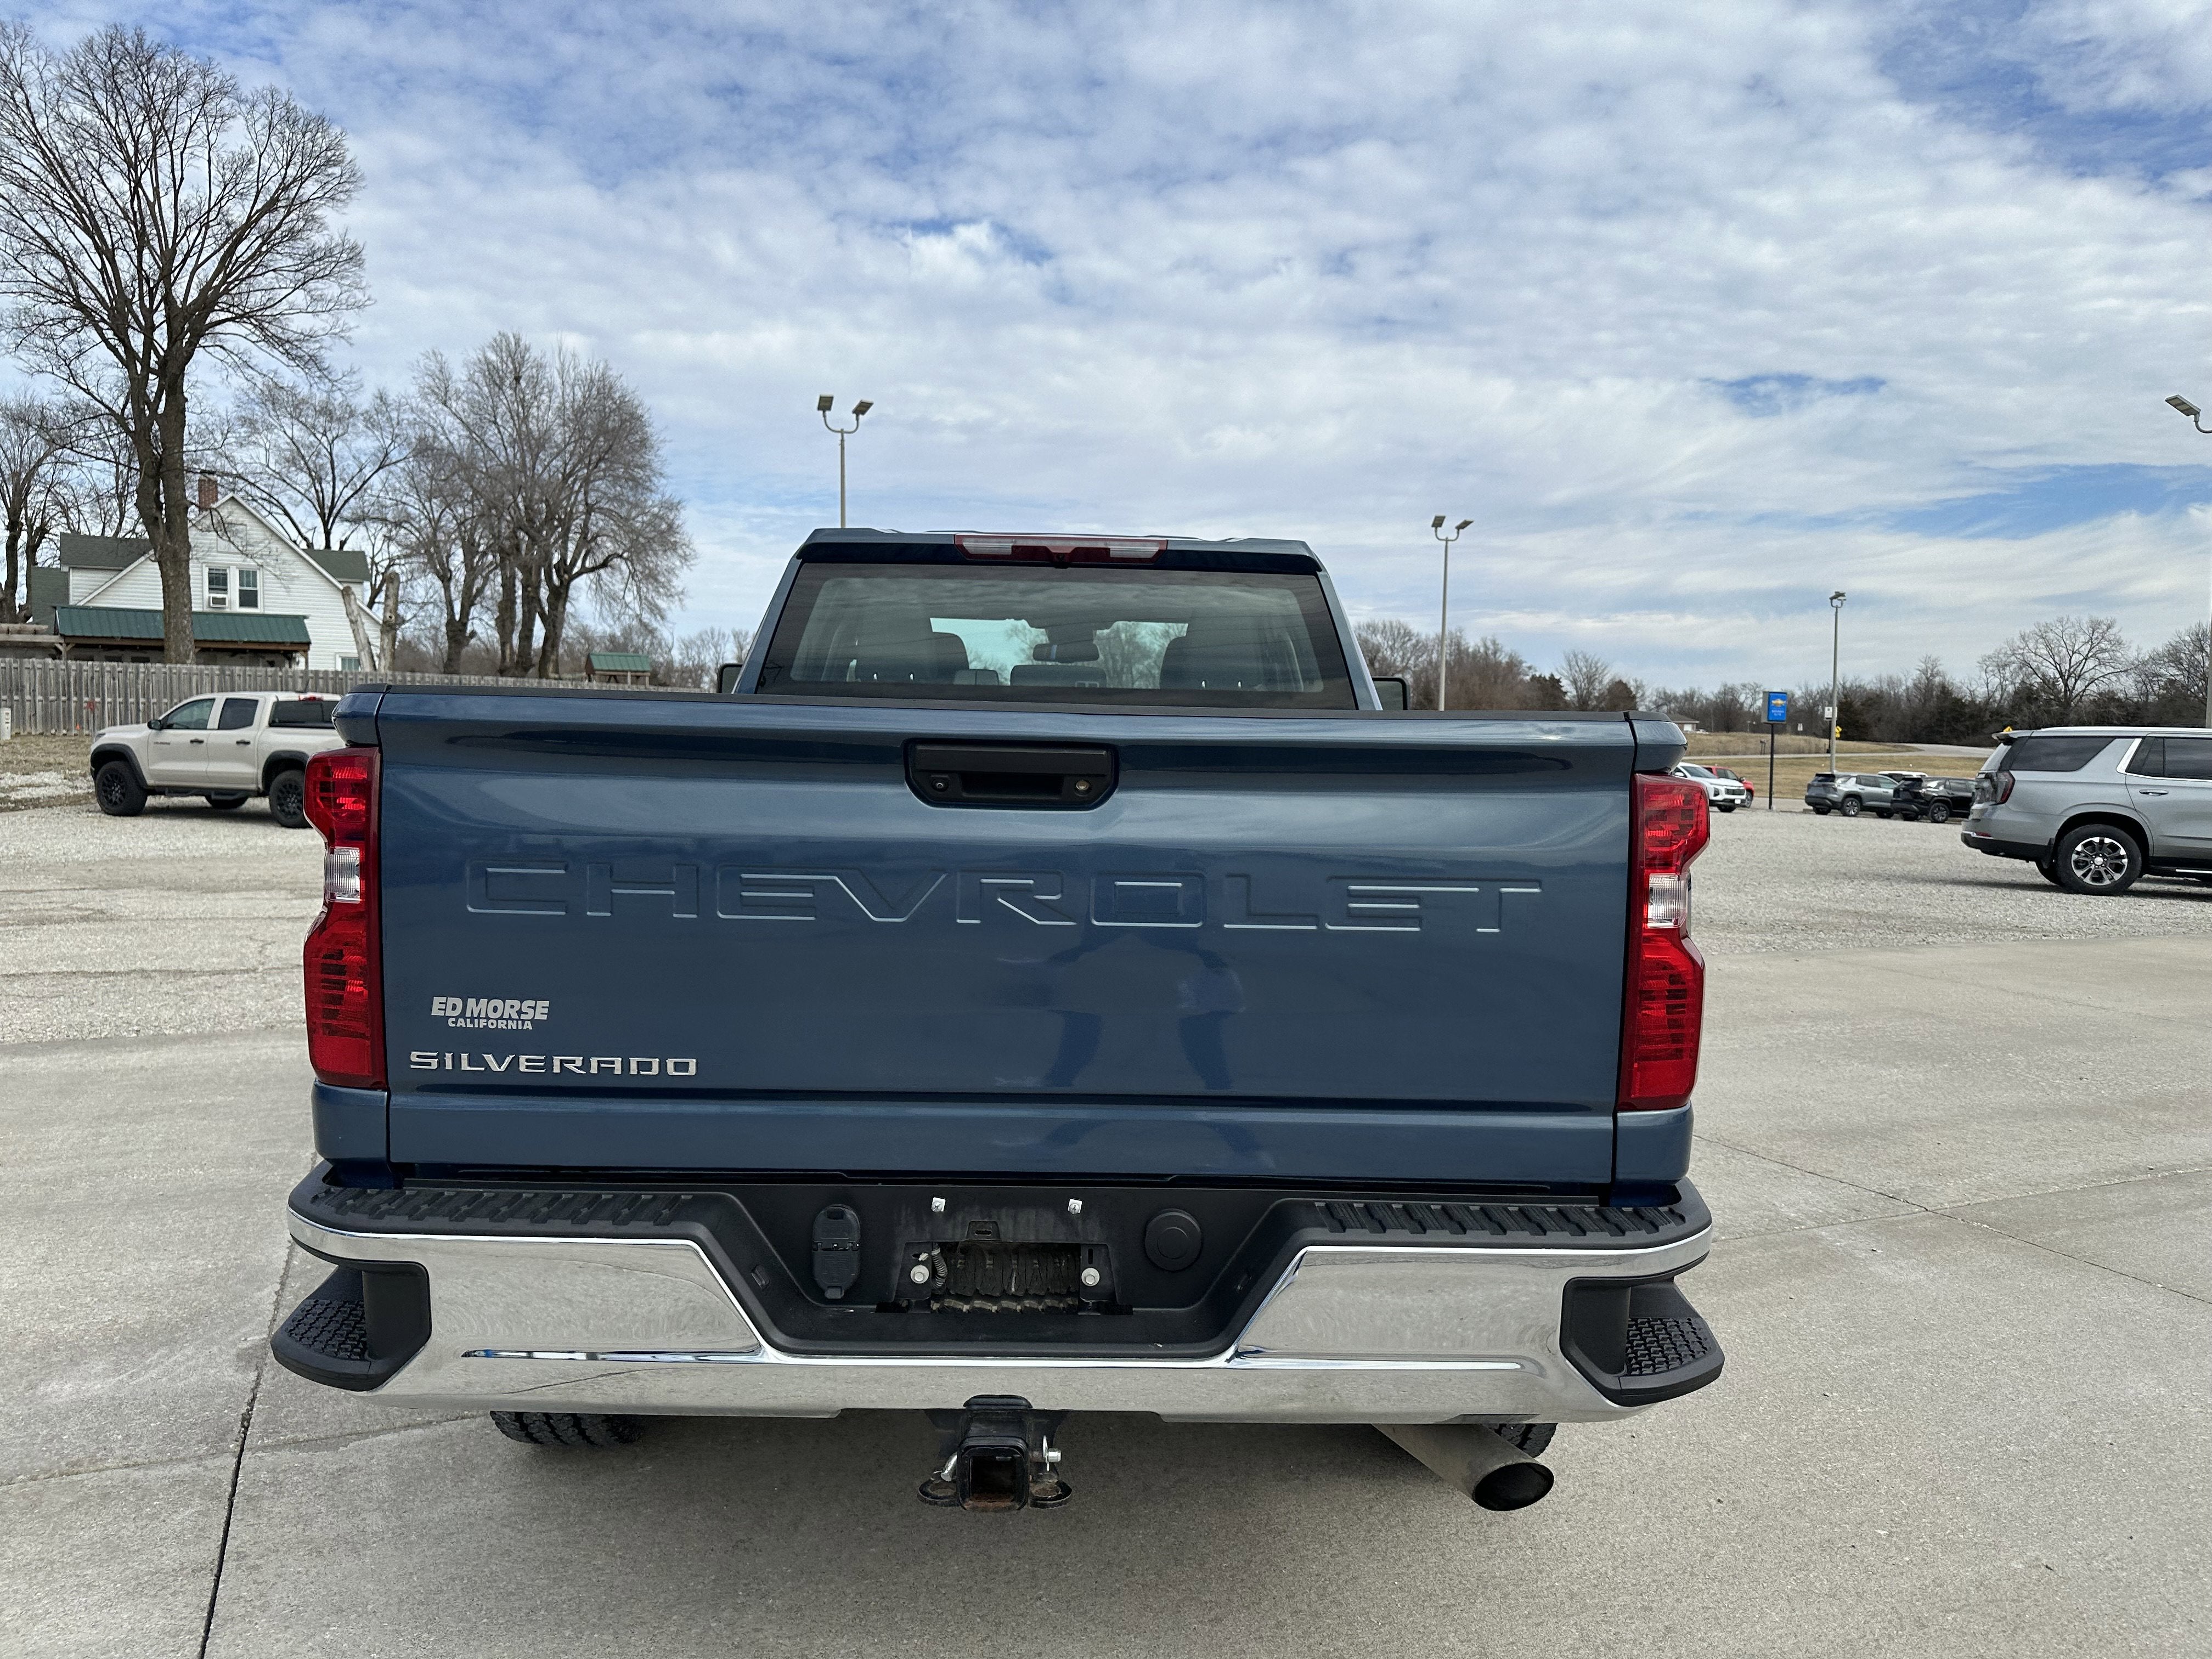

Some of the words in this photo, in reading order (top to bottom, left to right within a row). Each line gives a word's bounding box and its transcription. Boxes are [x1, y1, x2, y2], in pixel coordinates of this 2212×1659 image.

[466, 859, 1542, 933] CHEVROLET
[431, 996, 463, 1017] ED
[465, 998, 550, 1020] MORSE
[448, 1017, 533, 1030] CALIFORNIA
[410, 1051, 697, 1076] SILVERADO
